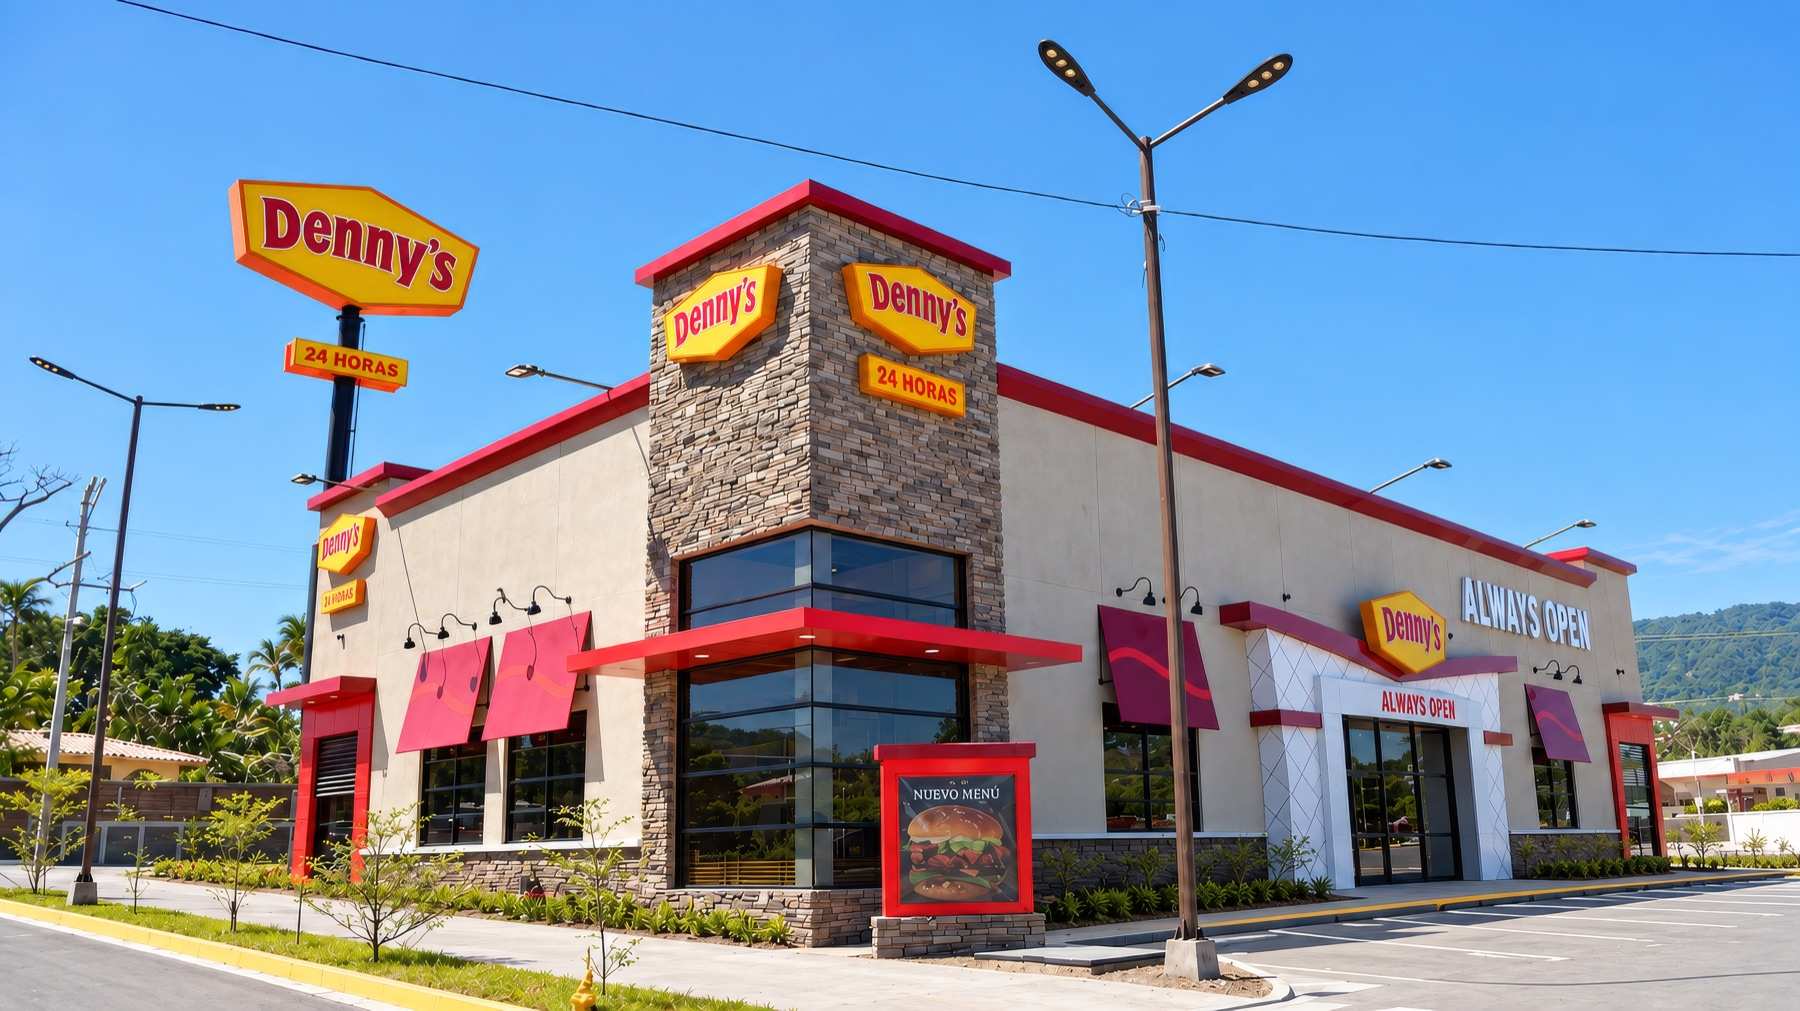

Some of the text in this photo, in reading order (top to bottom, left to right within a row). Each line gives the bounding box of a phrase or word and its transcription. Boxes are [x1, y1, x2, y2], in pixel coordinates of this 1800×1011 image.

[260, 196, 457, 292] Denny's
[674, 277, 757, 348] Denny's
[868, 272, 967, 337] Denny's
[305, 346, 399, 377] 24 HORAS
[877, 365, 957, 406] 24 HORAS
[321, 523, 360, 561] Denny's
[1382, 606, 1440, 654] Denny's
[1461, 578, 1591, 651] ALWAYS OPEN
[1381, 690, 1456, 720] ALWAYS OPEN
[914, 785, 1000, 801] NUEVO MENÚ
